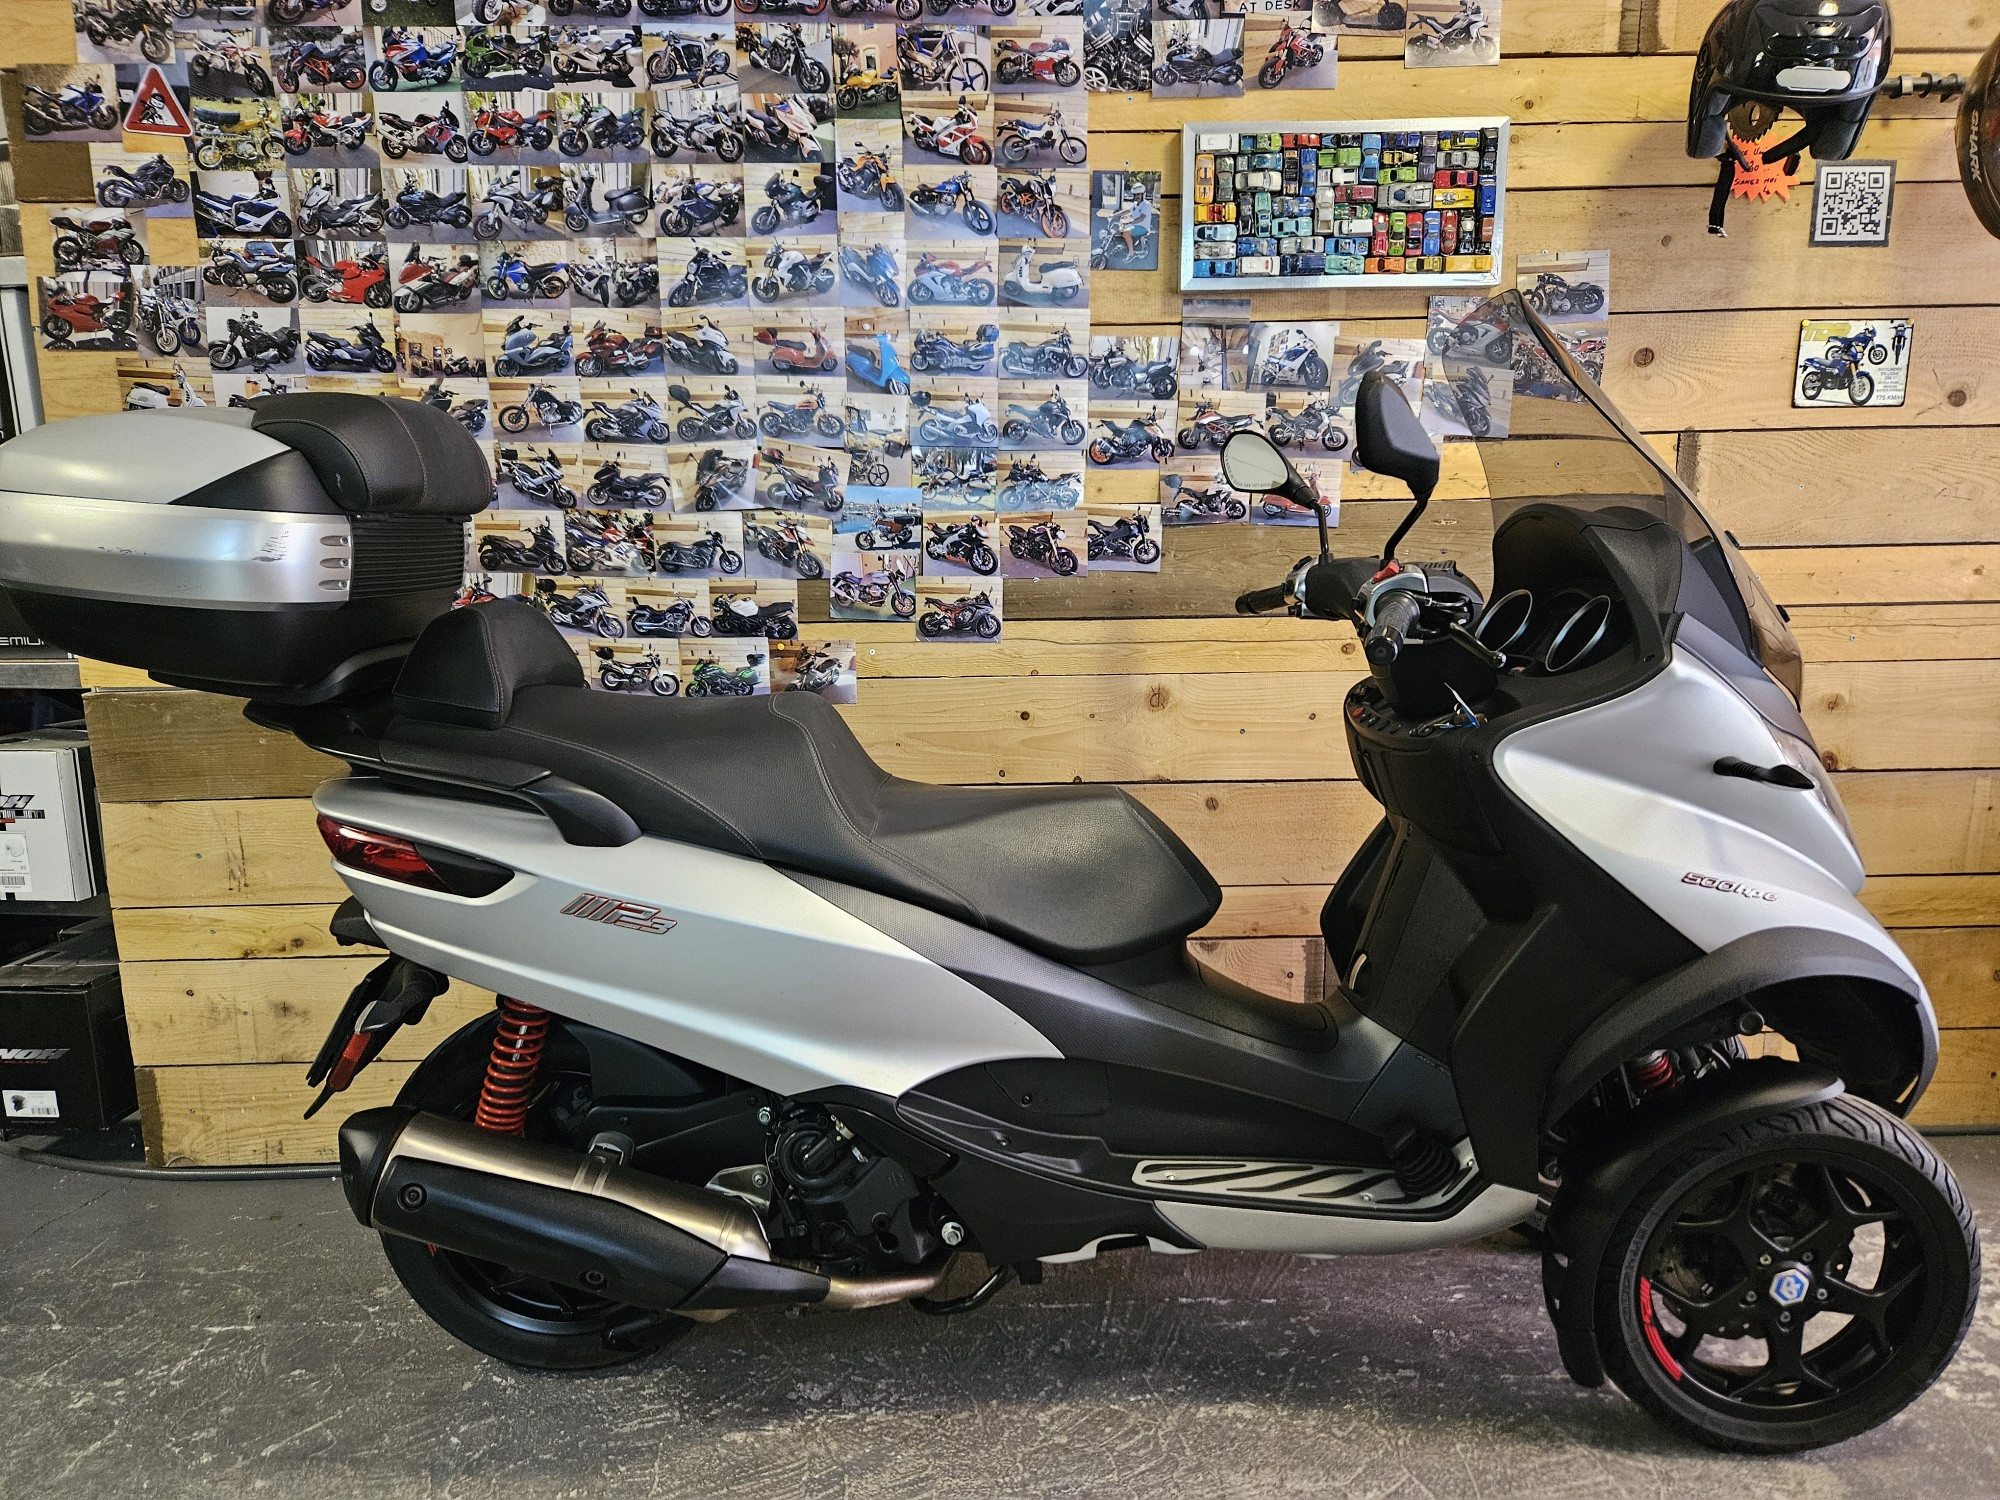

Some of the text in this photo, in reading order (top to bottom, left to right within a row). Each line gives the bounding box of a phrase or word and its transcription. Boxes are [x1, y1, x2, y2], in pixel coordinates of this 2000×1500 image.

[1240, 0, 1301, 13] AT DESK
[1970, 109, 1982, 183] SHARK
[0, 637, 44, 646] EMIU
[560, 892, 678, 935] MP3
